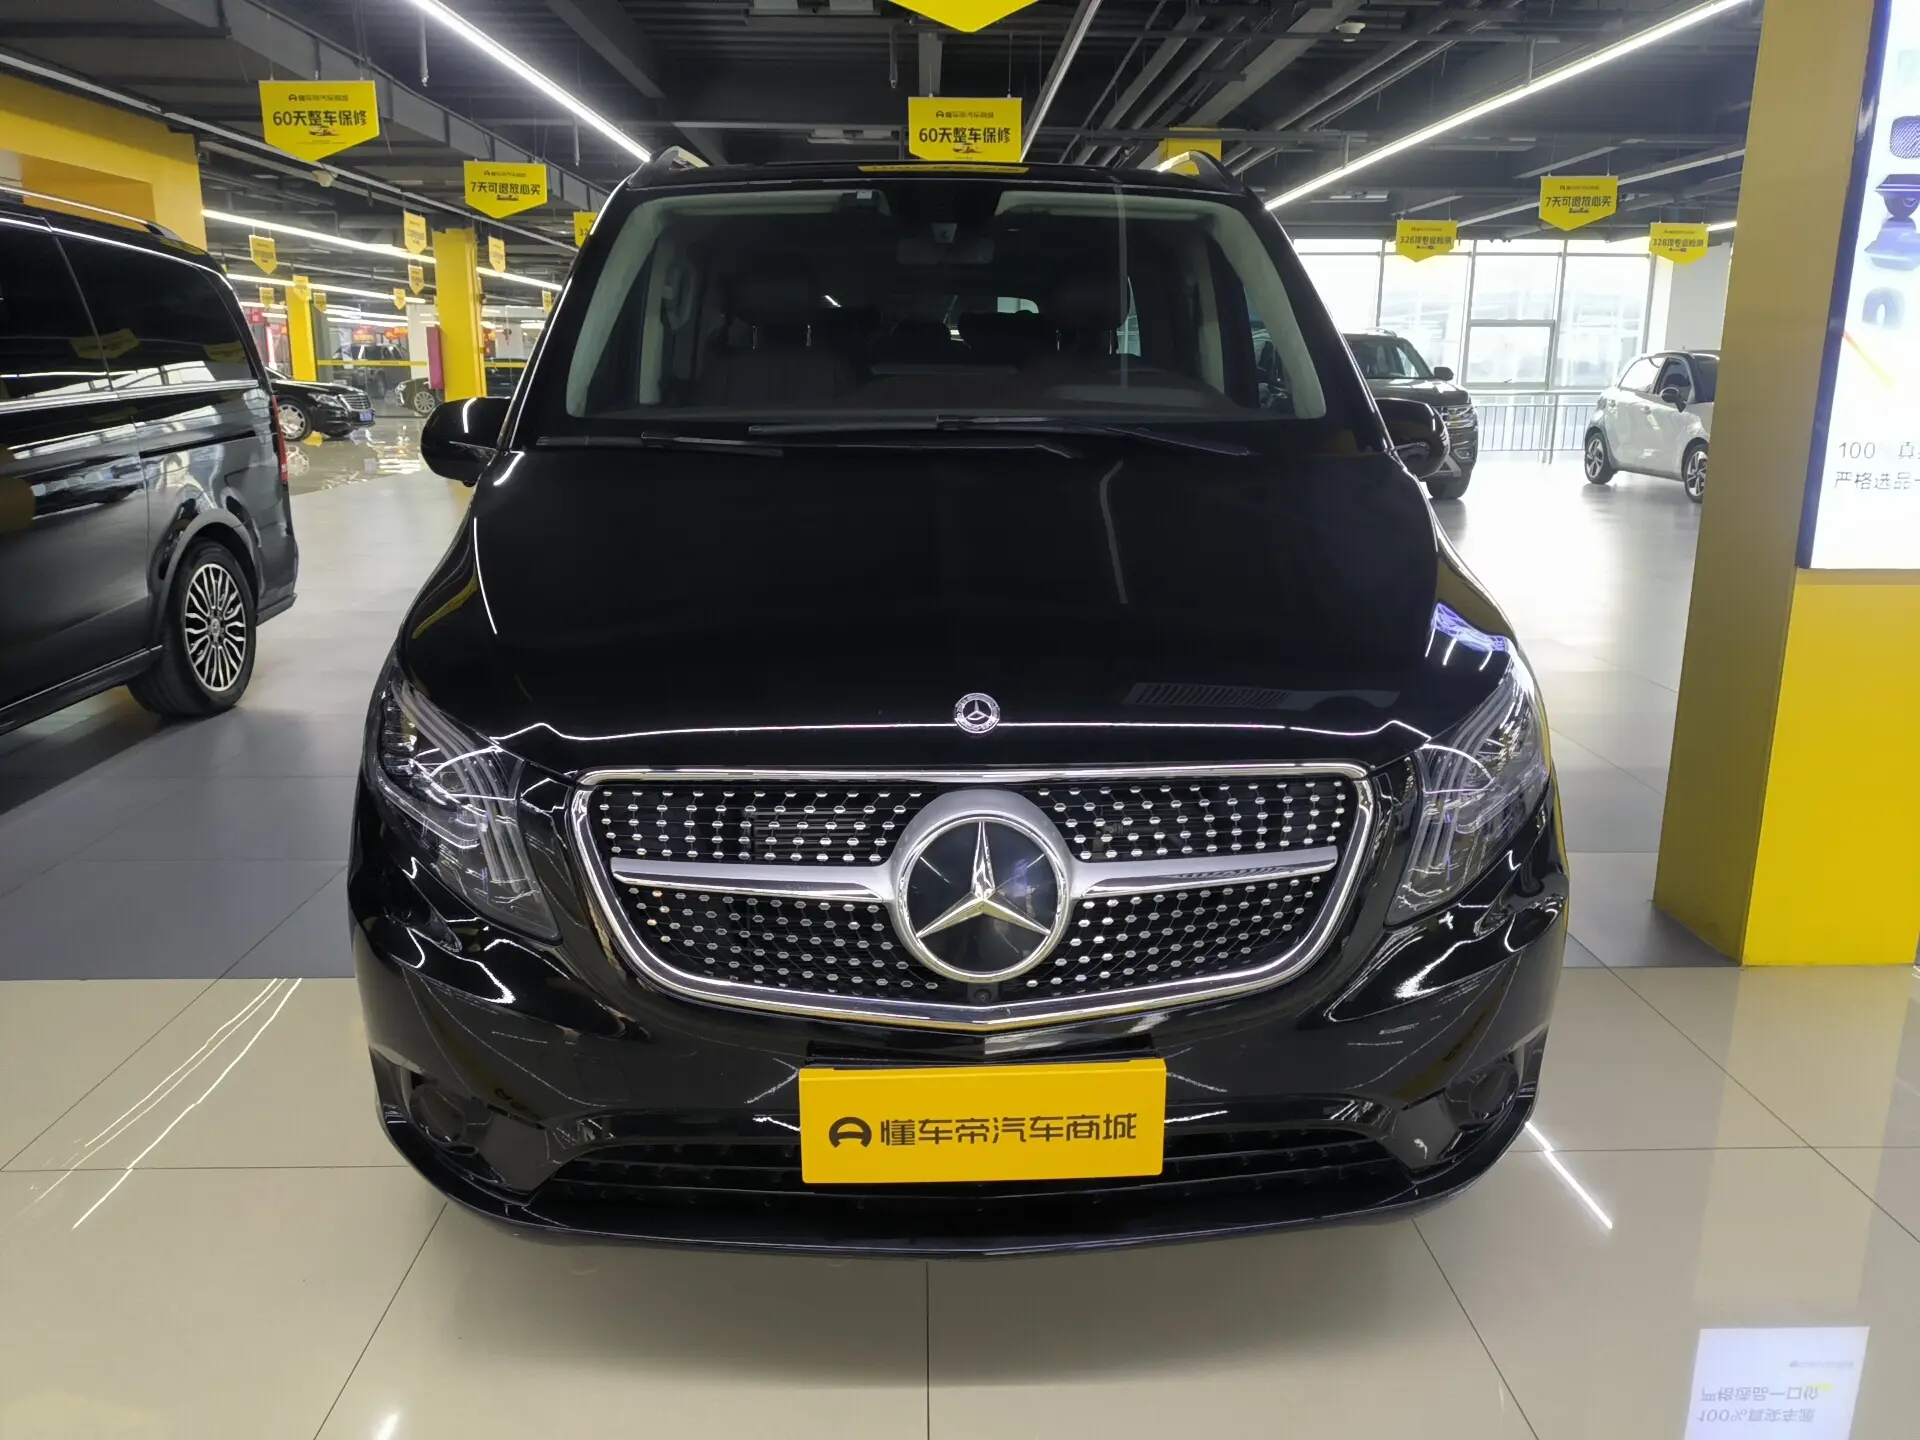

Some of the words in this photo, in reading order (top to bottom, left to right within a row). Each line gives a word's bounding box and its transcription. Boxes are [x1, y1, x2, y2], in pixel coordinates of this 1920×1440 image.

[273, 110, 368, 127] 60天整车保修
[919, 127, 1011, 143] 60天整车保修
[471, 181, 541, 196] 7天可退放心买
[1545, 195, 1612, 207] 7天可退放心买
[880, 1113, 1138, 1147] 懂车帝汽车商城
